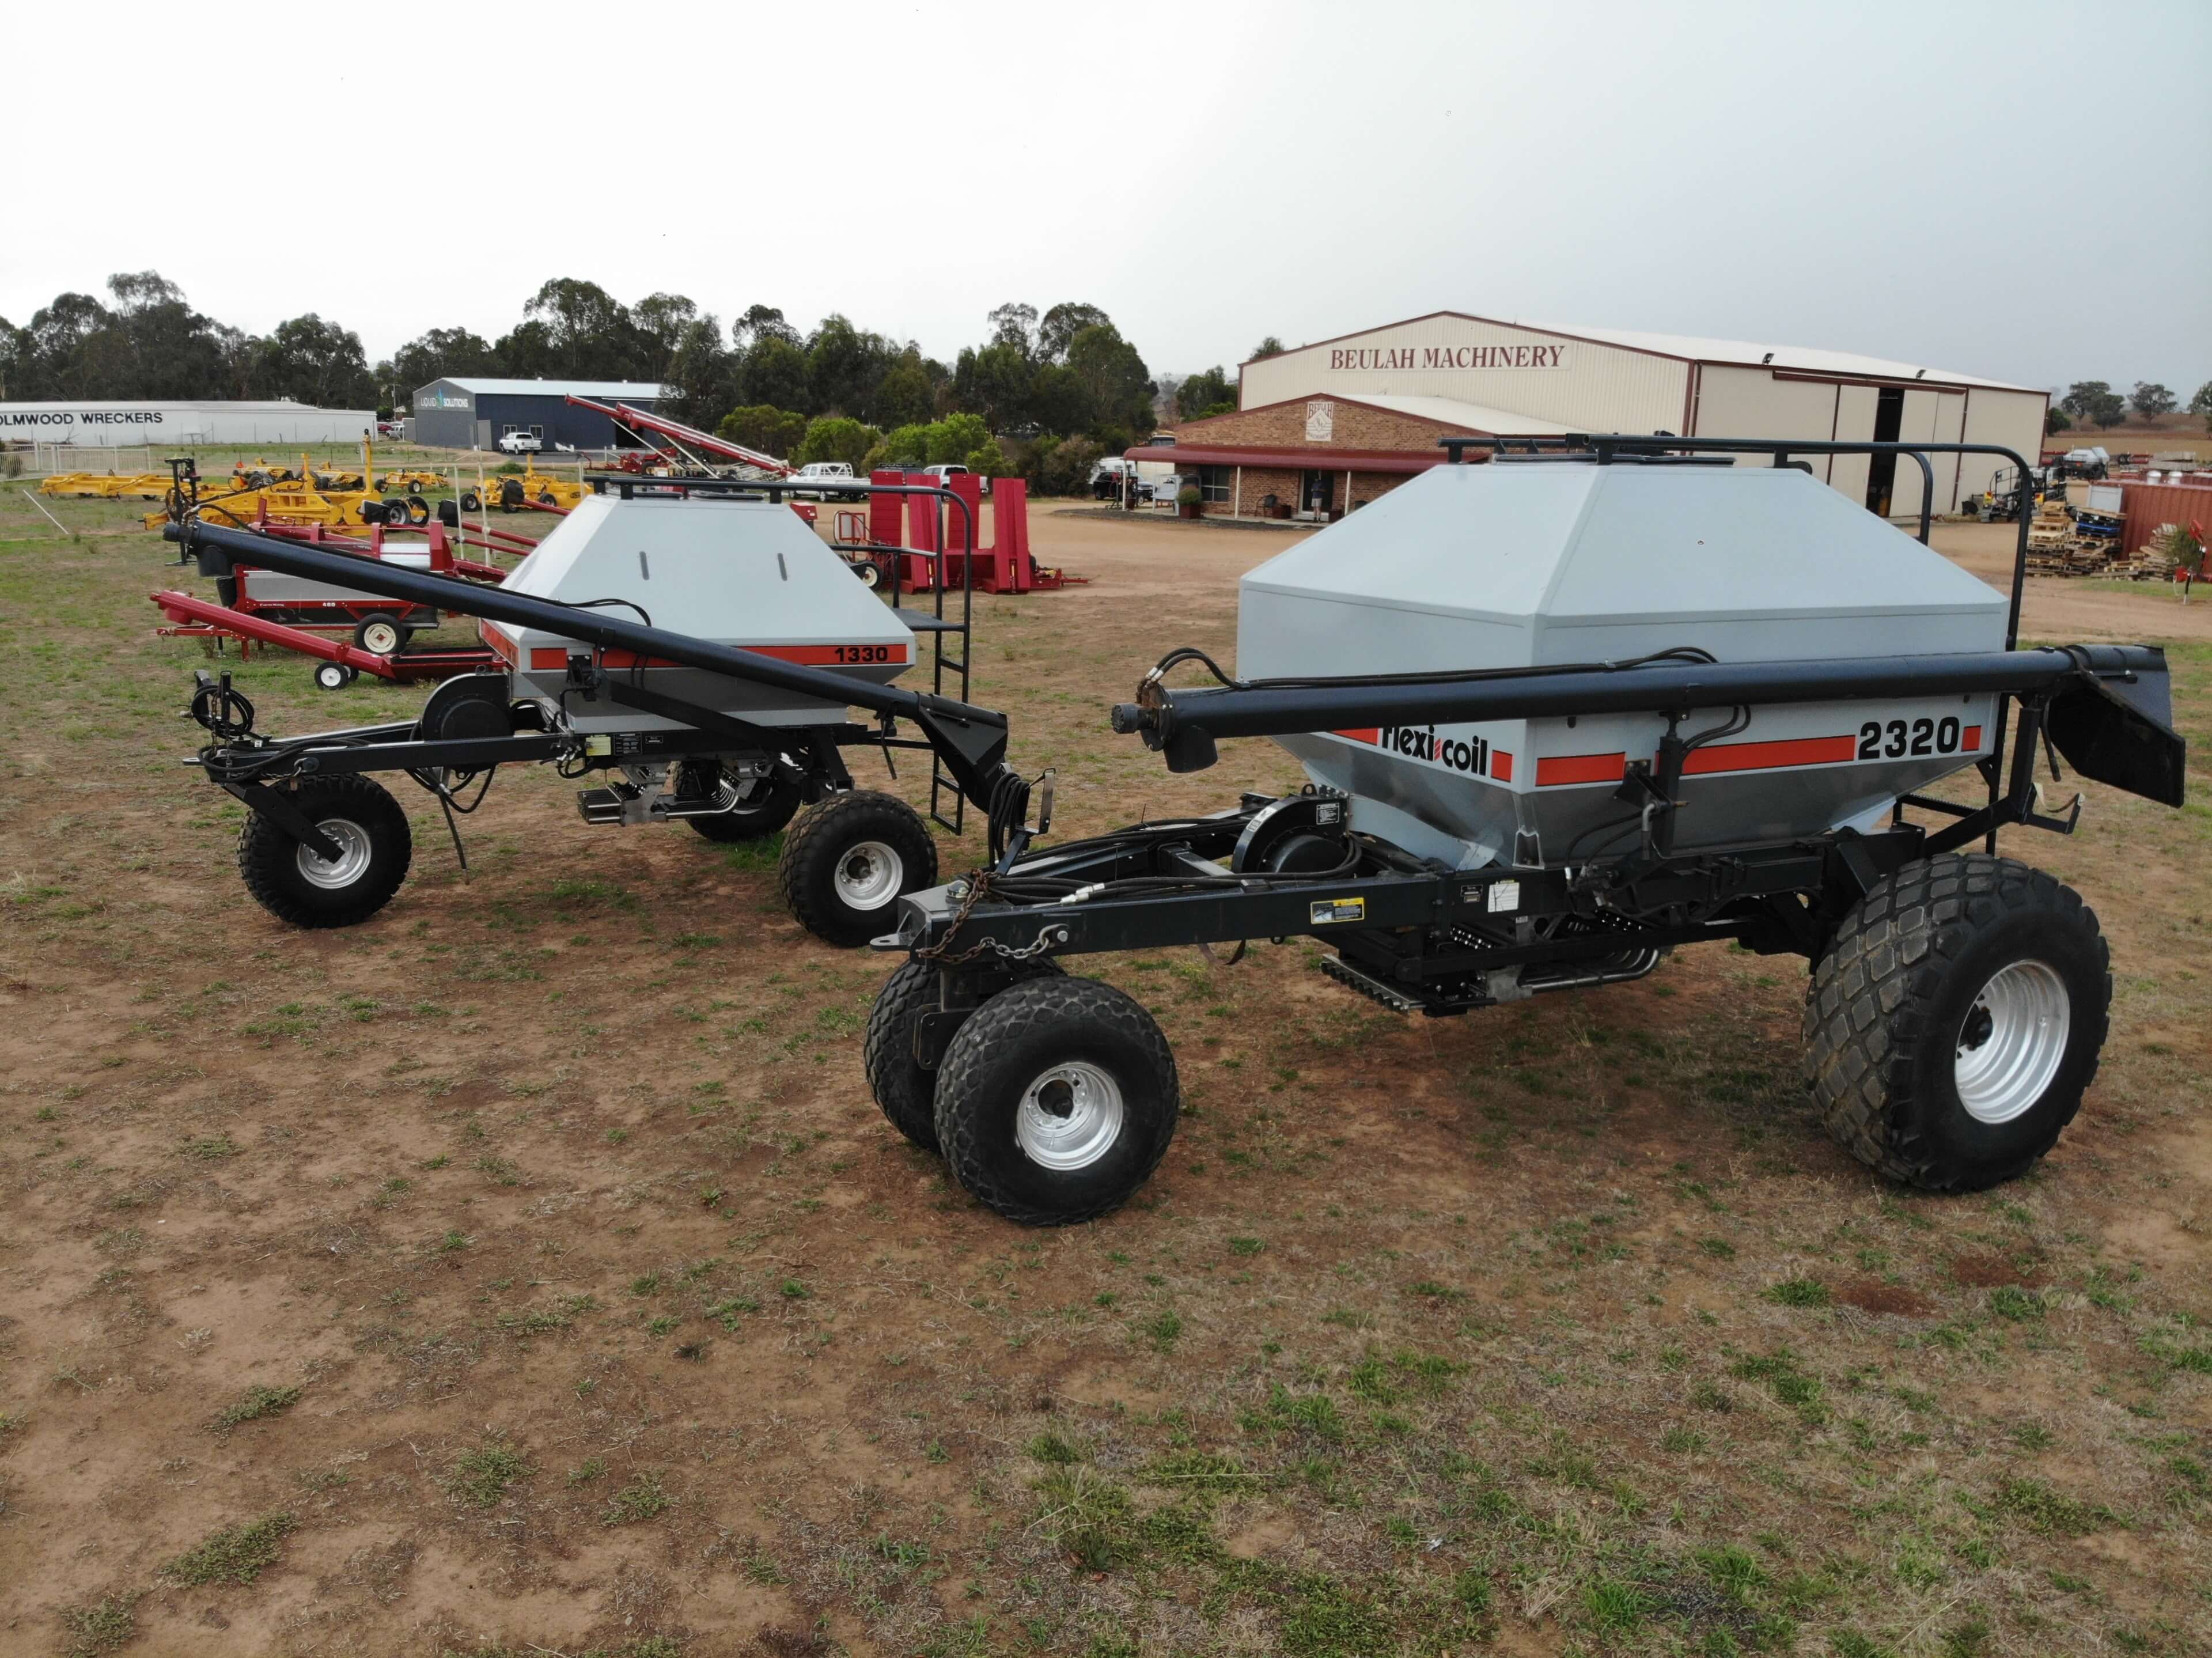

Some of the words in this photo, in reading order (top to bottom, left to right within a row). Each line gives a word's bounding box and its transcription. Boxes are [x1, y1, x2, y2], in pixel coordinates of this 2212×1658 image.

[1330, 349, 1415, 369] BEULAH
[1422, 346, 1565, 369] MACHINERY
[420, 398, 436, 407] LIQUID
[443, 398, 468, 408] SOLUTIONS
[0, 414, 74, 426] LMWOOD
[81, 412, 163, 423] WRECKERS
[834, 647, 888, 662] 1330
[1858, 717, 1960, 760] 2320
